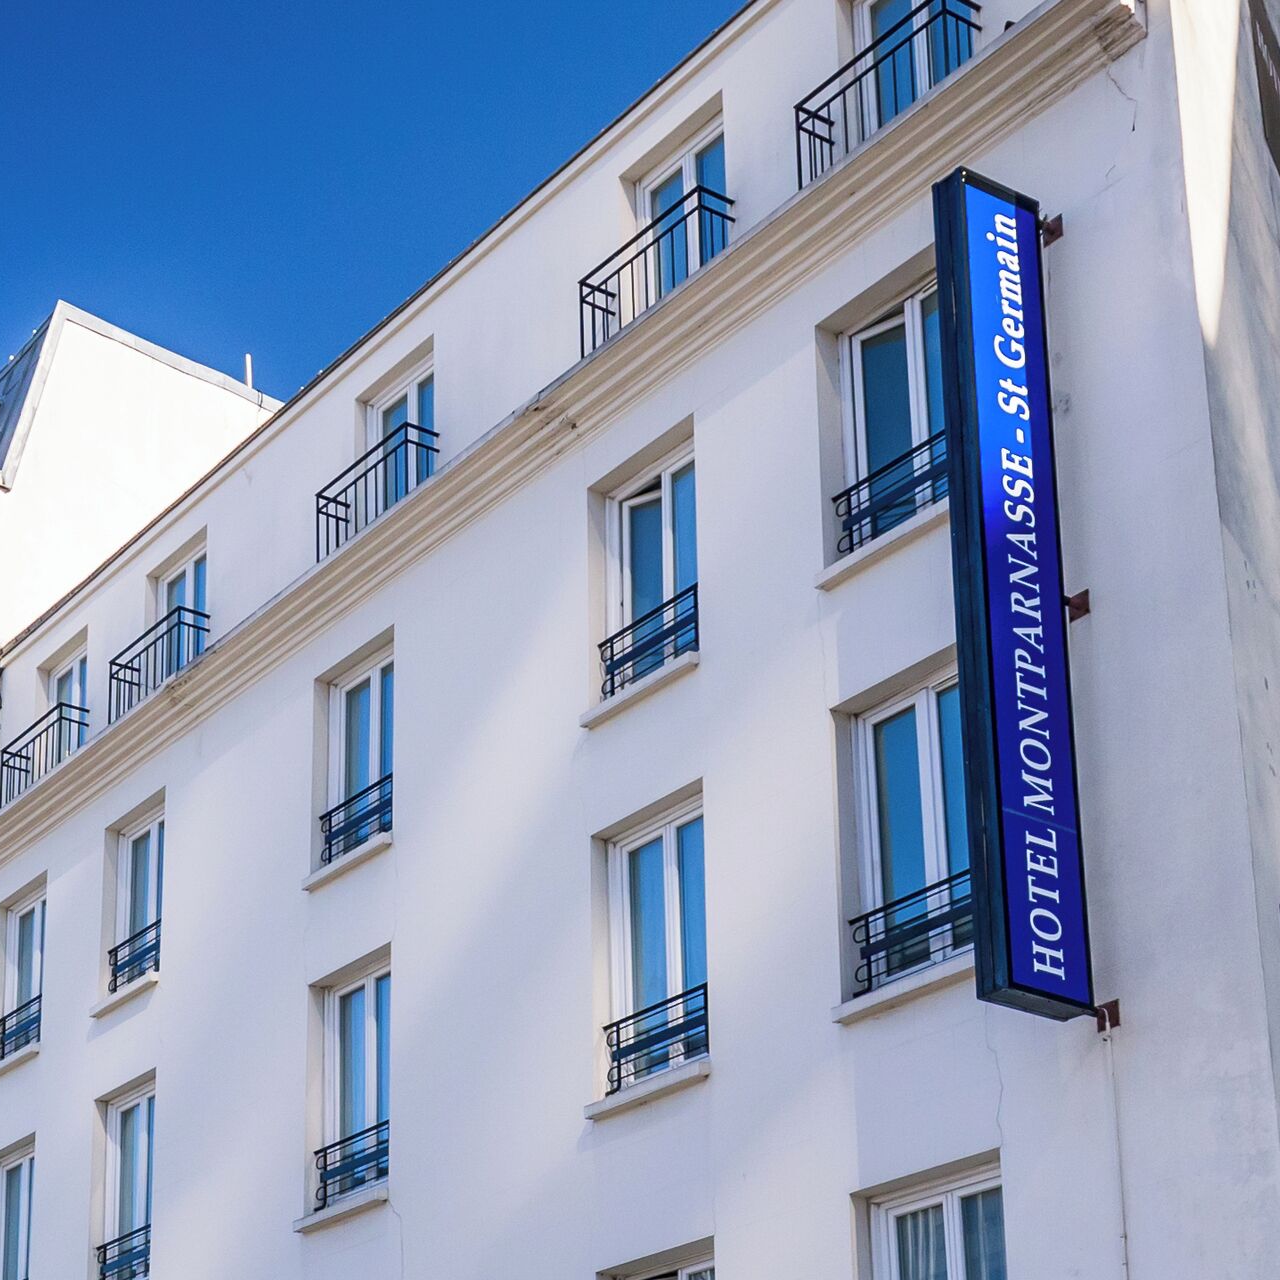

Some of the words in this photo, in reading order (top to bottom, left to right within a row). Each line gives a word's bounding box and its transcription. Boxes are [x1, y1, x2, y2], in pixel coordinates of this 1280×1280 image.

[985, 212, 1026, 370] Germain
[997, 377, 1031, 421] St
[1001, 447, 1055, 816] MONTPARNASSE
[1025, 828, 1065, 981] HOTEL
